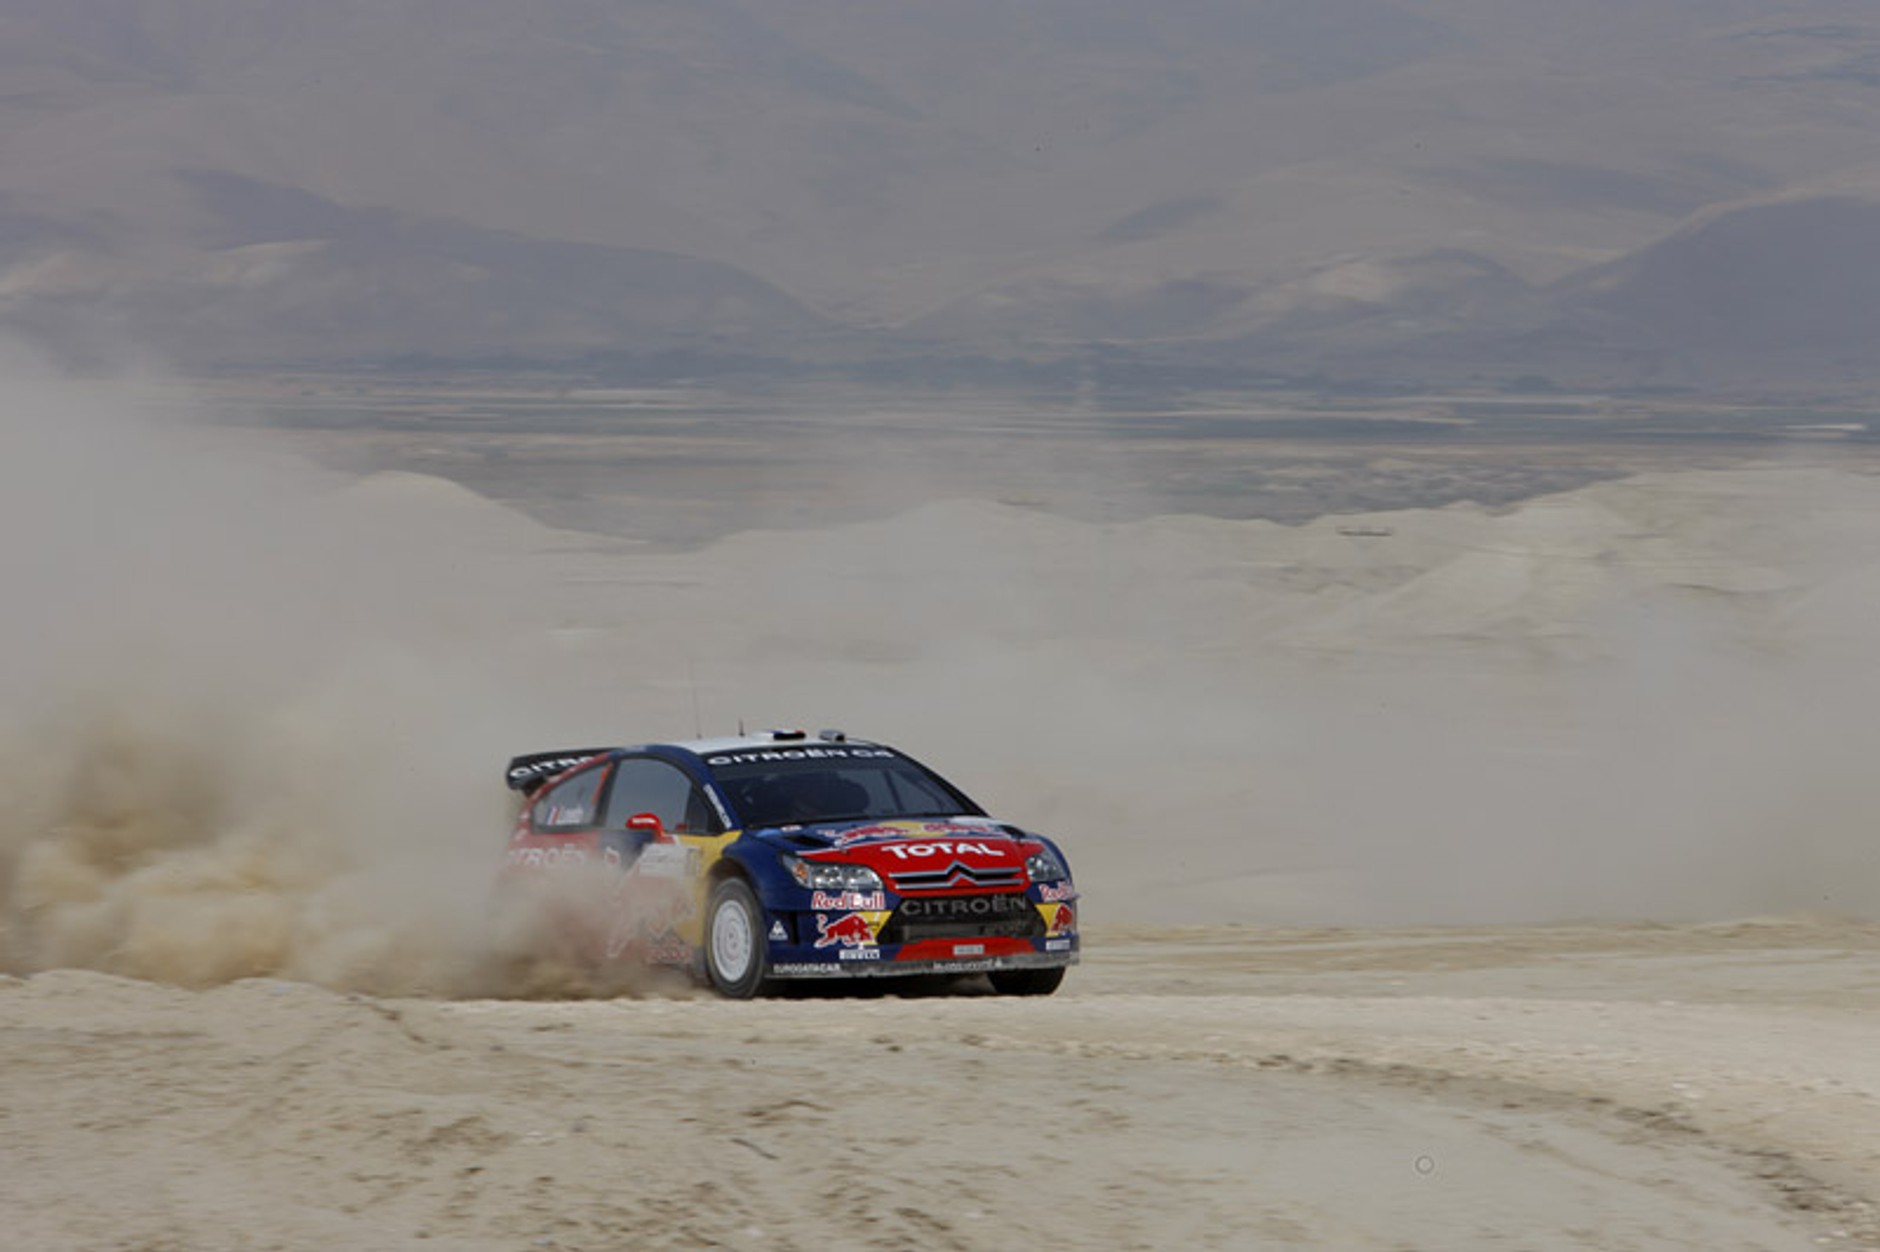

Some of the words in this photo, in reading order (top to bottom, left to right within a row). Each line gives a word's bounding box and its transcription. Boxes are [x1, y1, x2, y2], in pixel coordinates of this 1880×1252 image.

[881, 842, 1004, 859] TOTAL
[812, 891, 845, 909] Red
[849, 891, 885, 909] Bull
[900, 895, 1026, 915] CITROËN
